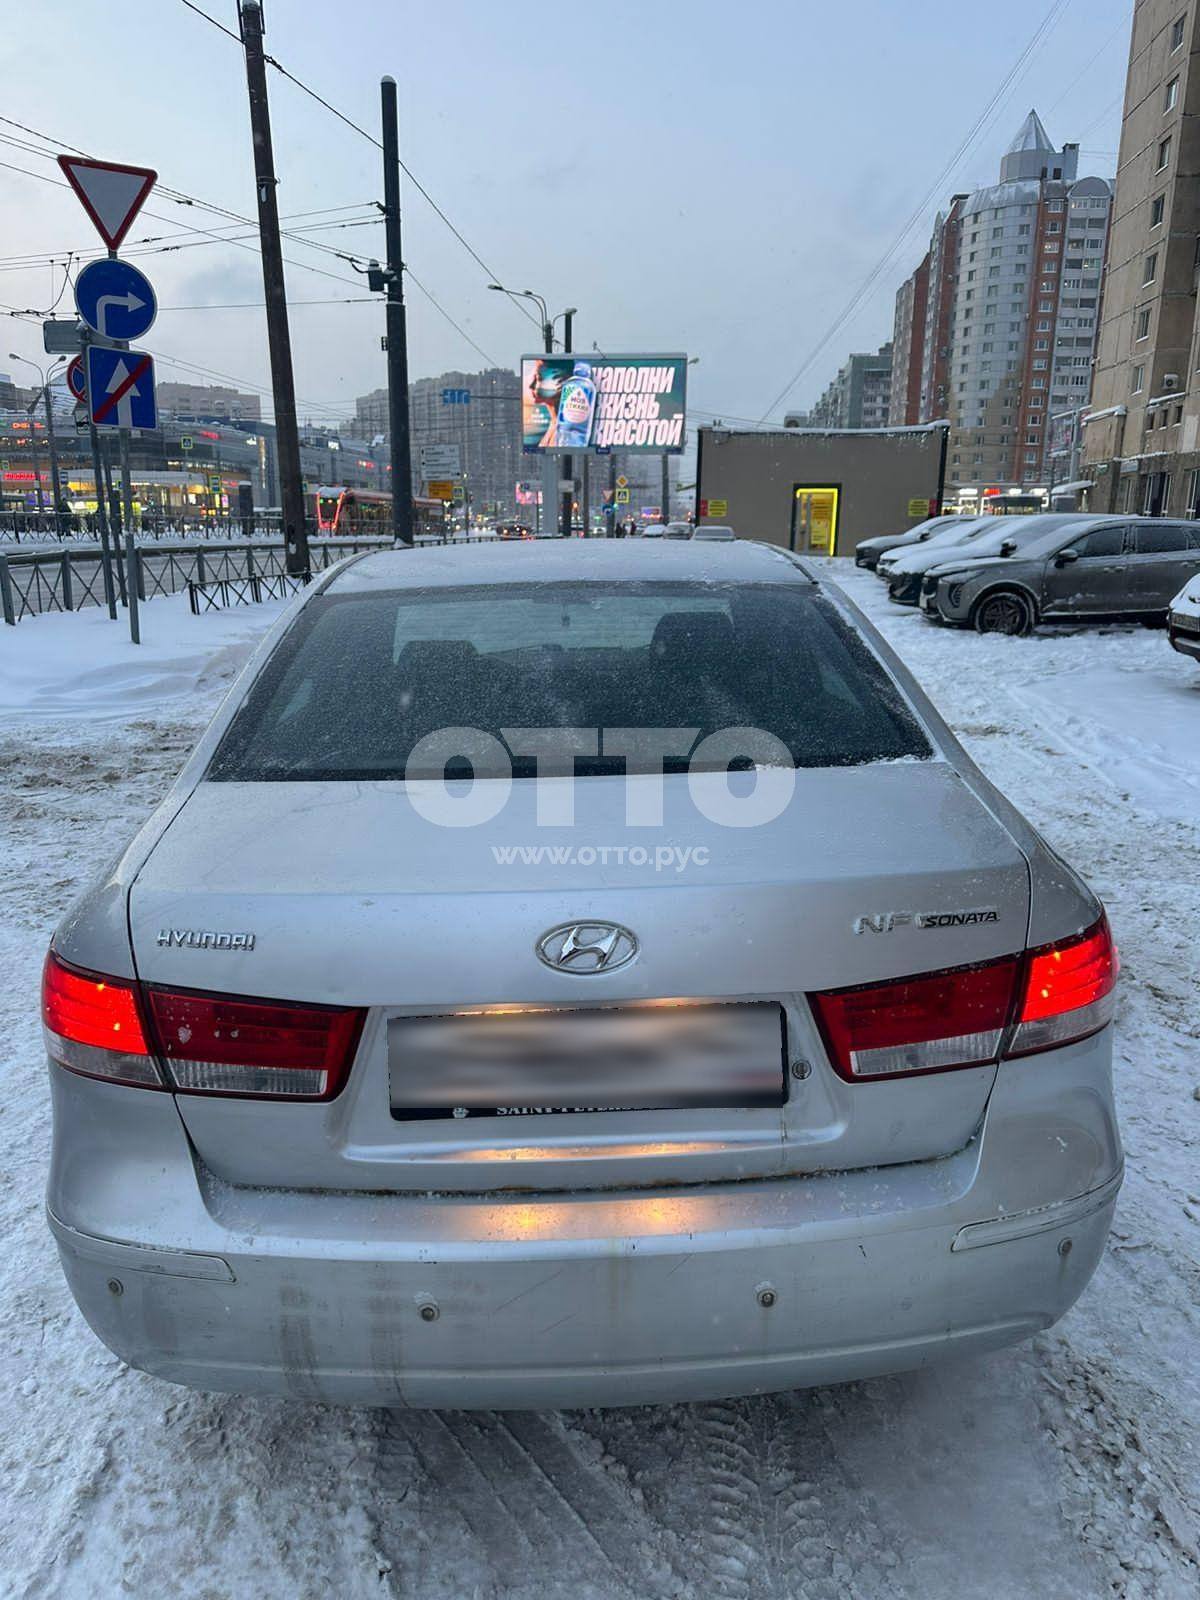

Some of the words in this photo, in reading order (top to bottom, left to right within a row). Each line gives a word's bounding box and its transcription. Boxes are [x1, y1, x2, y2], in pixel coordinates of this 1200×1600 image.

[853, 911, 913, 935] NF
[923, 910, 1000, 929] SONATA
[156, 929, 256, 951] HYUNDAI
